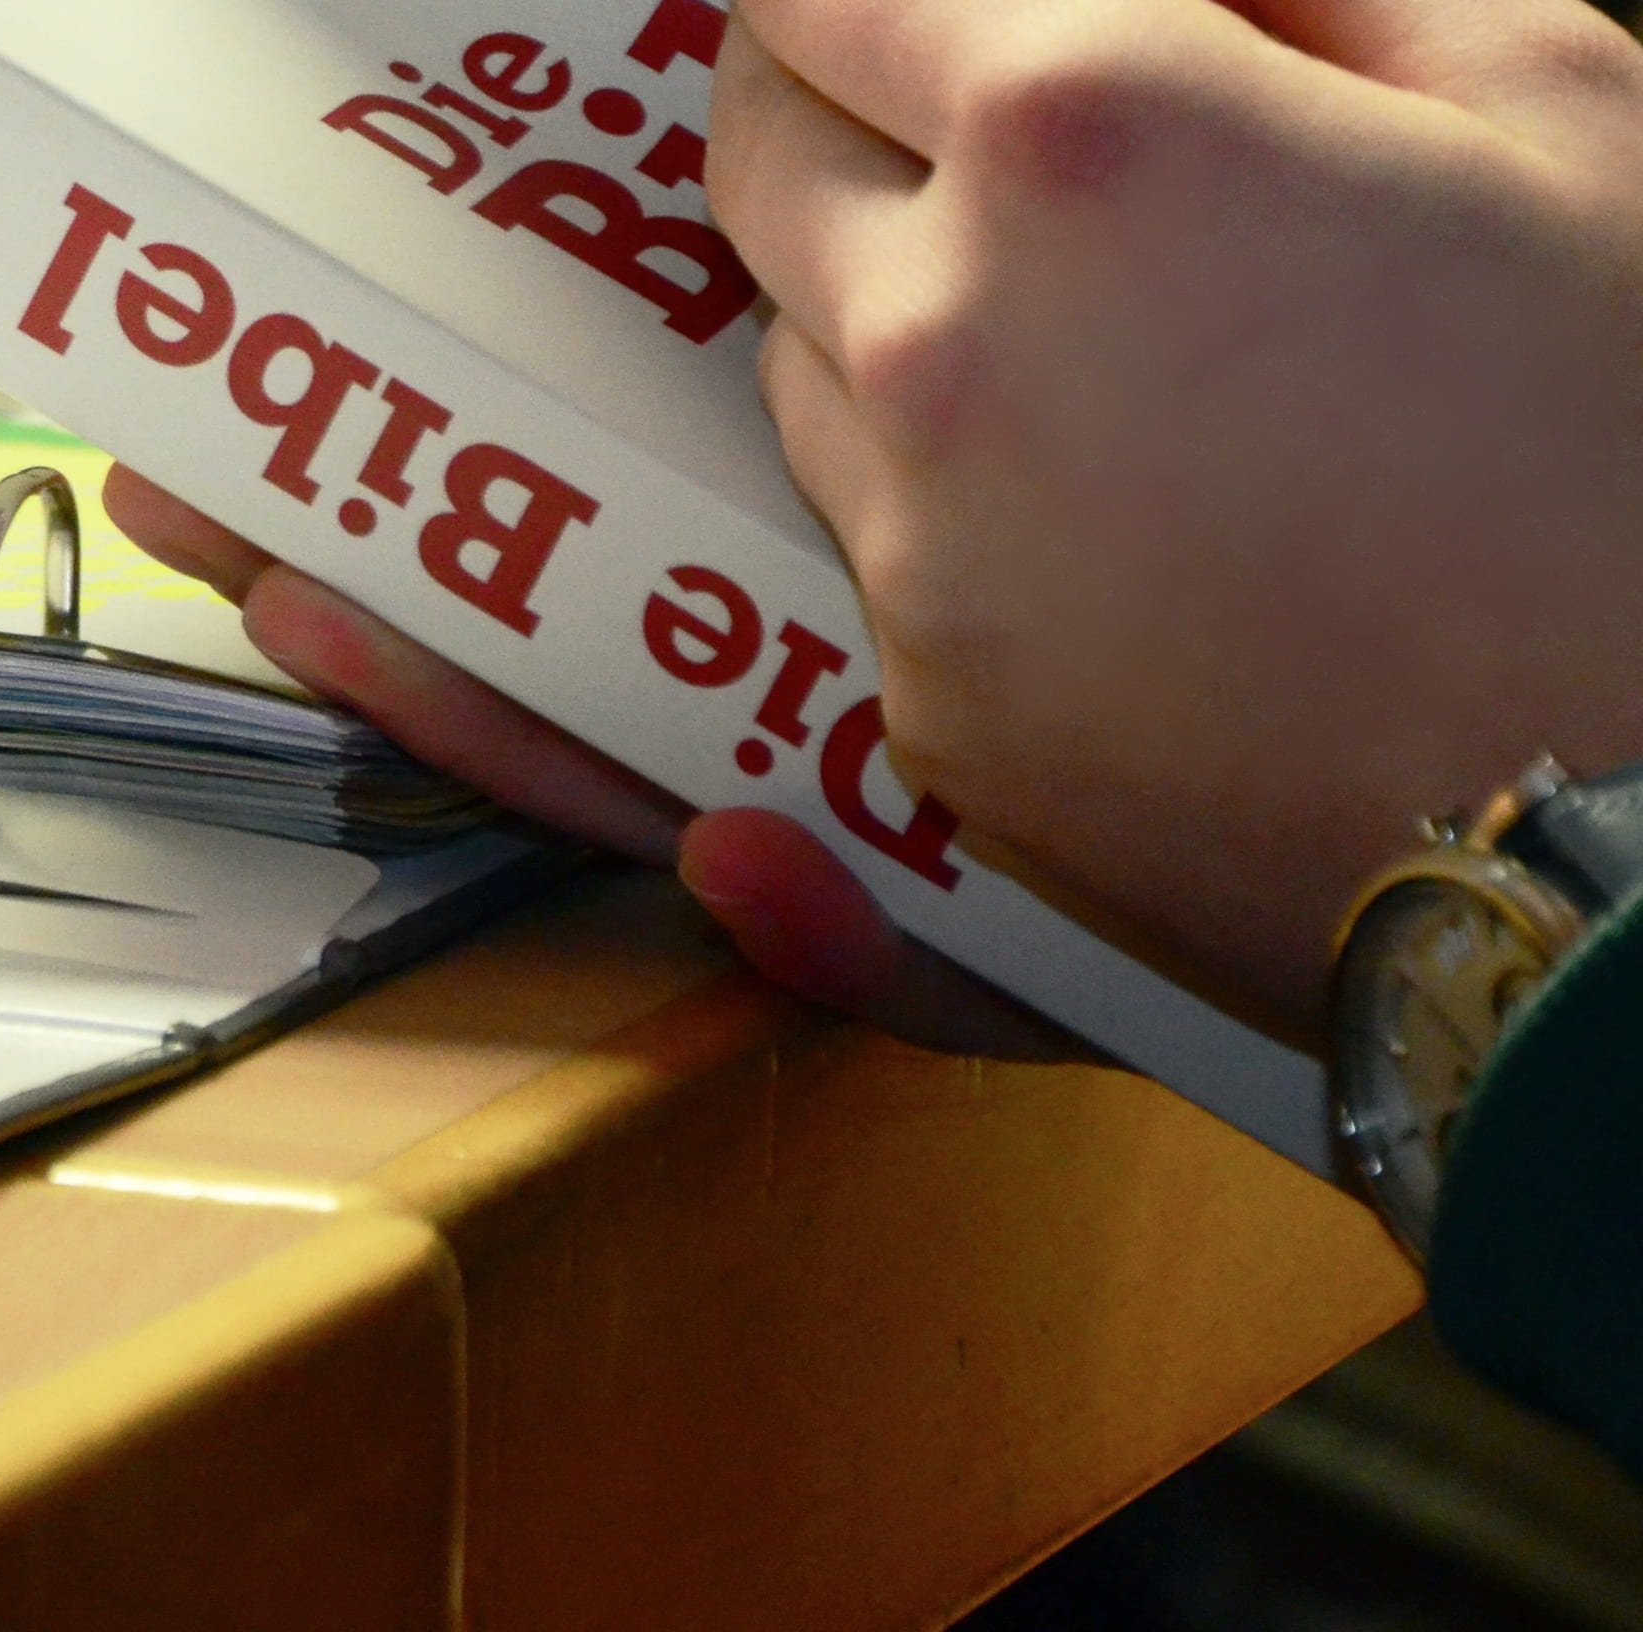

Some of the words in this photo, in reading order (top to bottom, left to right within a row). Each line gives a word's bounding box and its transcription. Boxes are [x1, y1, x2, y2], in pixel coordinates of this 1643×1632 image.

[321, 30, 574, 197] Die
[16, 182, 602, 638] Bibel
[642, 564, 963, 896] Die
